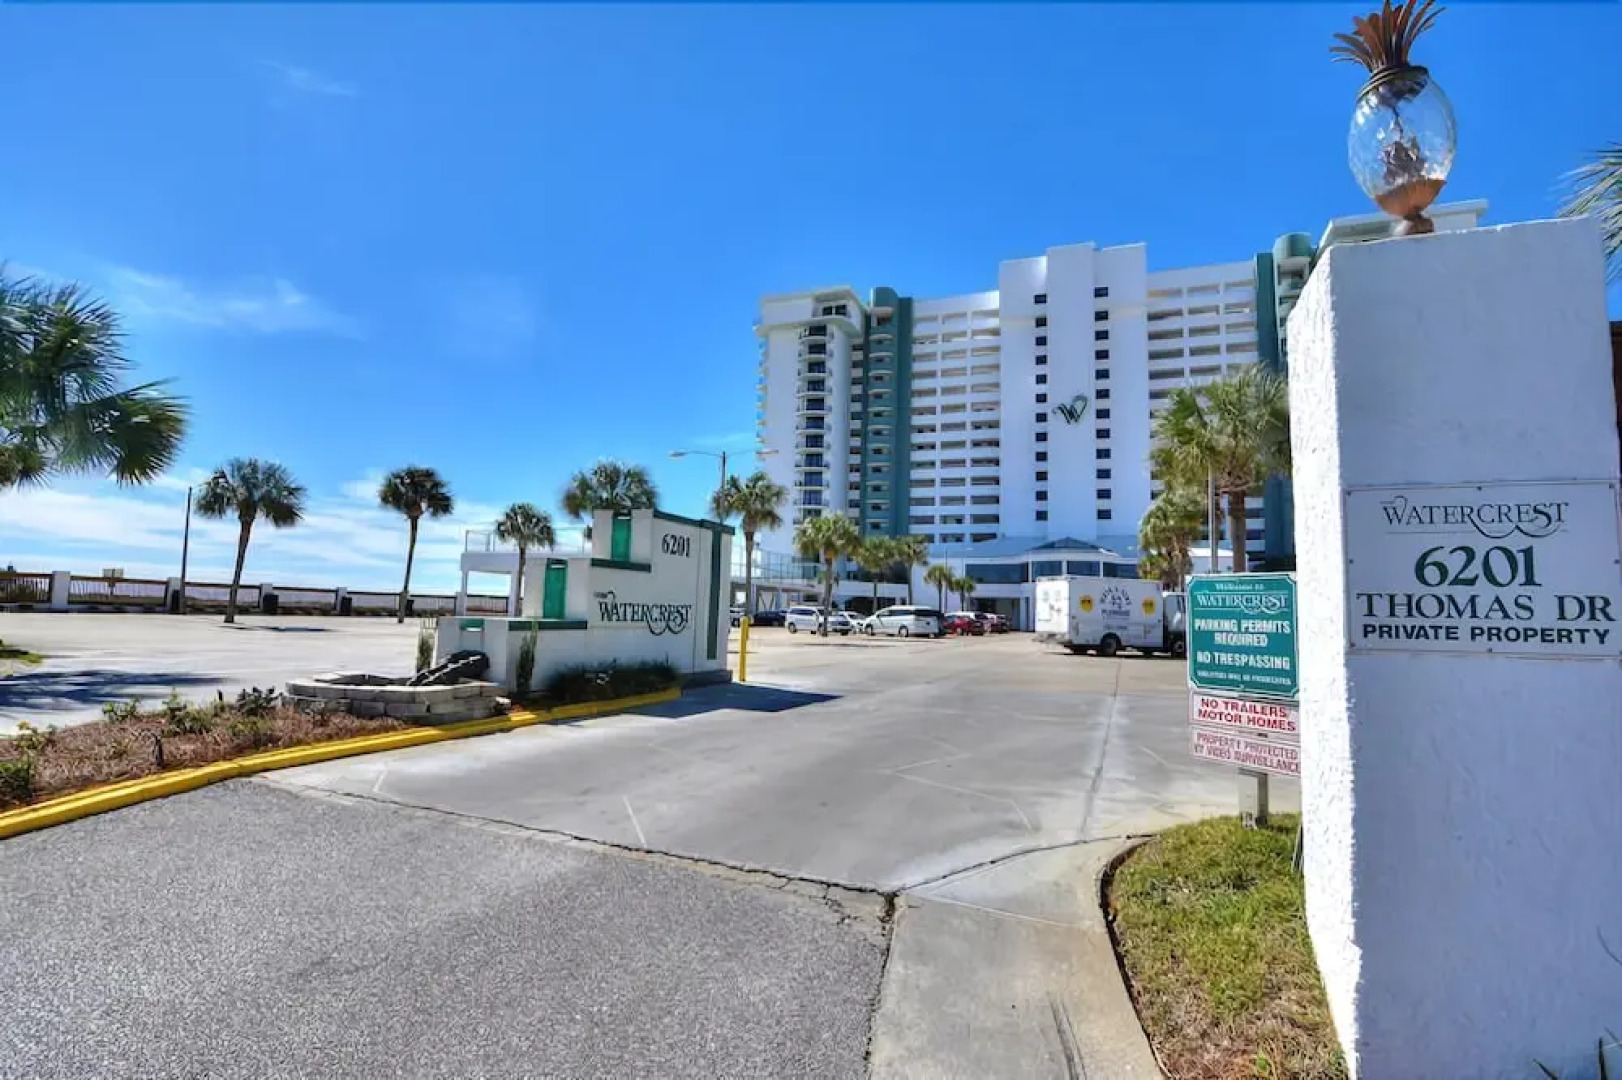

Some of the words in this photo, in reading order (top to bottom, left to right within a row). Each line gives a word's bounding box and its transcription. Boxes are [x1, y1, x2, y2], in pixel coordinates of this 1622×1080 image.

[1381, 499, 1569, 539] WATERCREST
[662, 533, 691, 558] 6201
[1414, 545, 1543, 588] 6201
[1196, 594, 1289, 614] WATERCREST
[1356, 592, 1535, 621] THOMAS
[1554, 594, 1617, 622] DR
[597, 600, 692, 636] WATERCREST
[1194, 618, 1238, 632] PARKING
[1241, 619, 1291, 635] PERMITS
[1214, 632, 1268, 648] REQUIRED
[1363, 624, 1460, 641] PRIVATE
[1470, 626, 1610, 645] PROPERTY
[1196, 651, 1211, 664] NO
[1213, 652, 1291, 670] TRESPASSING
[1201, 698, 1219, 709] NO
[1222, 700, 1287, 718] TRAILERS
[1198, 708, 1242, 723] MOTOR
[1247, 715, 1296, 732] HOMES
